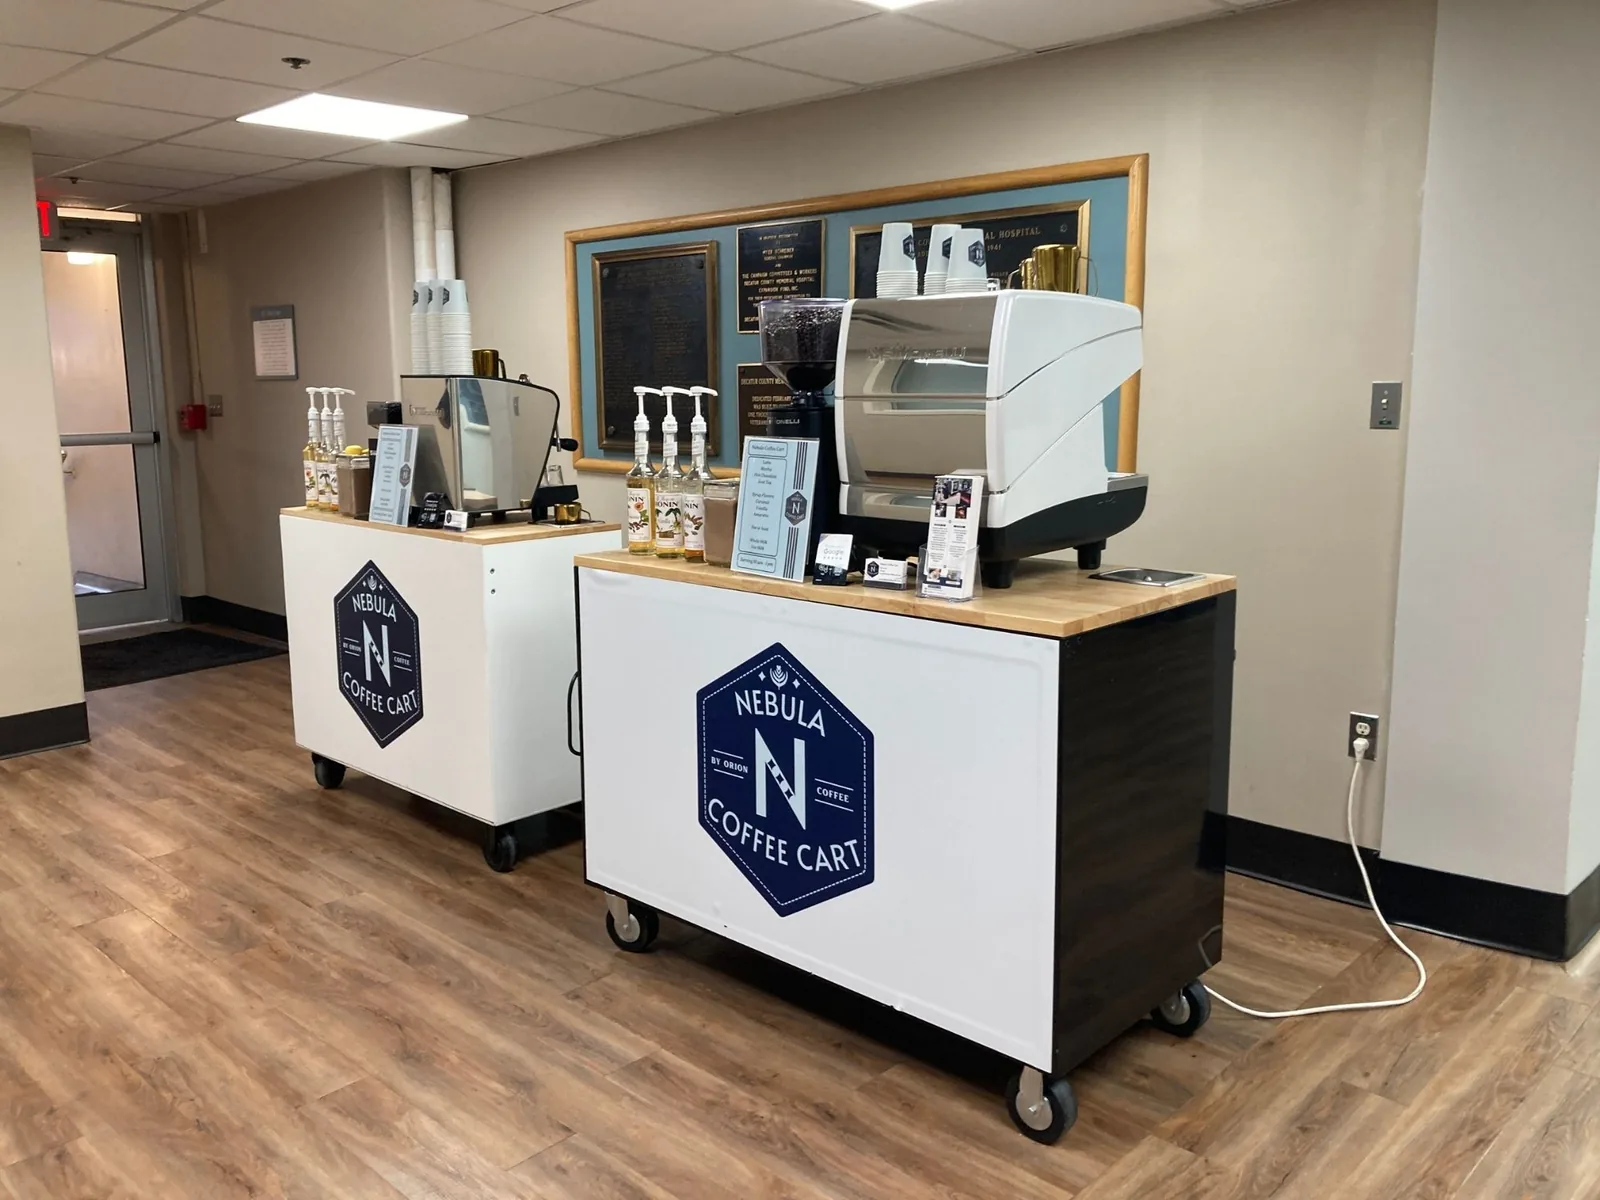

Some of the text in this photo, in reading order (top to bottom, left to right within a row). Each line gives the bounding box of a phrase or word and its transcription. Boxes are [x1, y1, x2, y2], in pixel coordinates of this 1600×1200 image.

[36, 201, 50, 236] T
[1000, 226, 1040, 239] HOSPITAL
[792, 502, 800, 514] N
[352, 593, 396, 622] NEBULA
[362, 620, 391, 687] N
[343, 671, 418, 714] COFFEE CART
[734, 690, 826, 738] NEBULA
[711, 756, 748, 774] BY ORION
[755, 727, 806, 830] N
[816, 786, 850, 803] COFFEE
[708, 798, 861, 872] COFFEE CART
